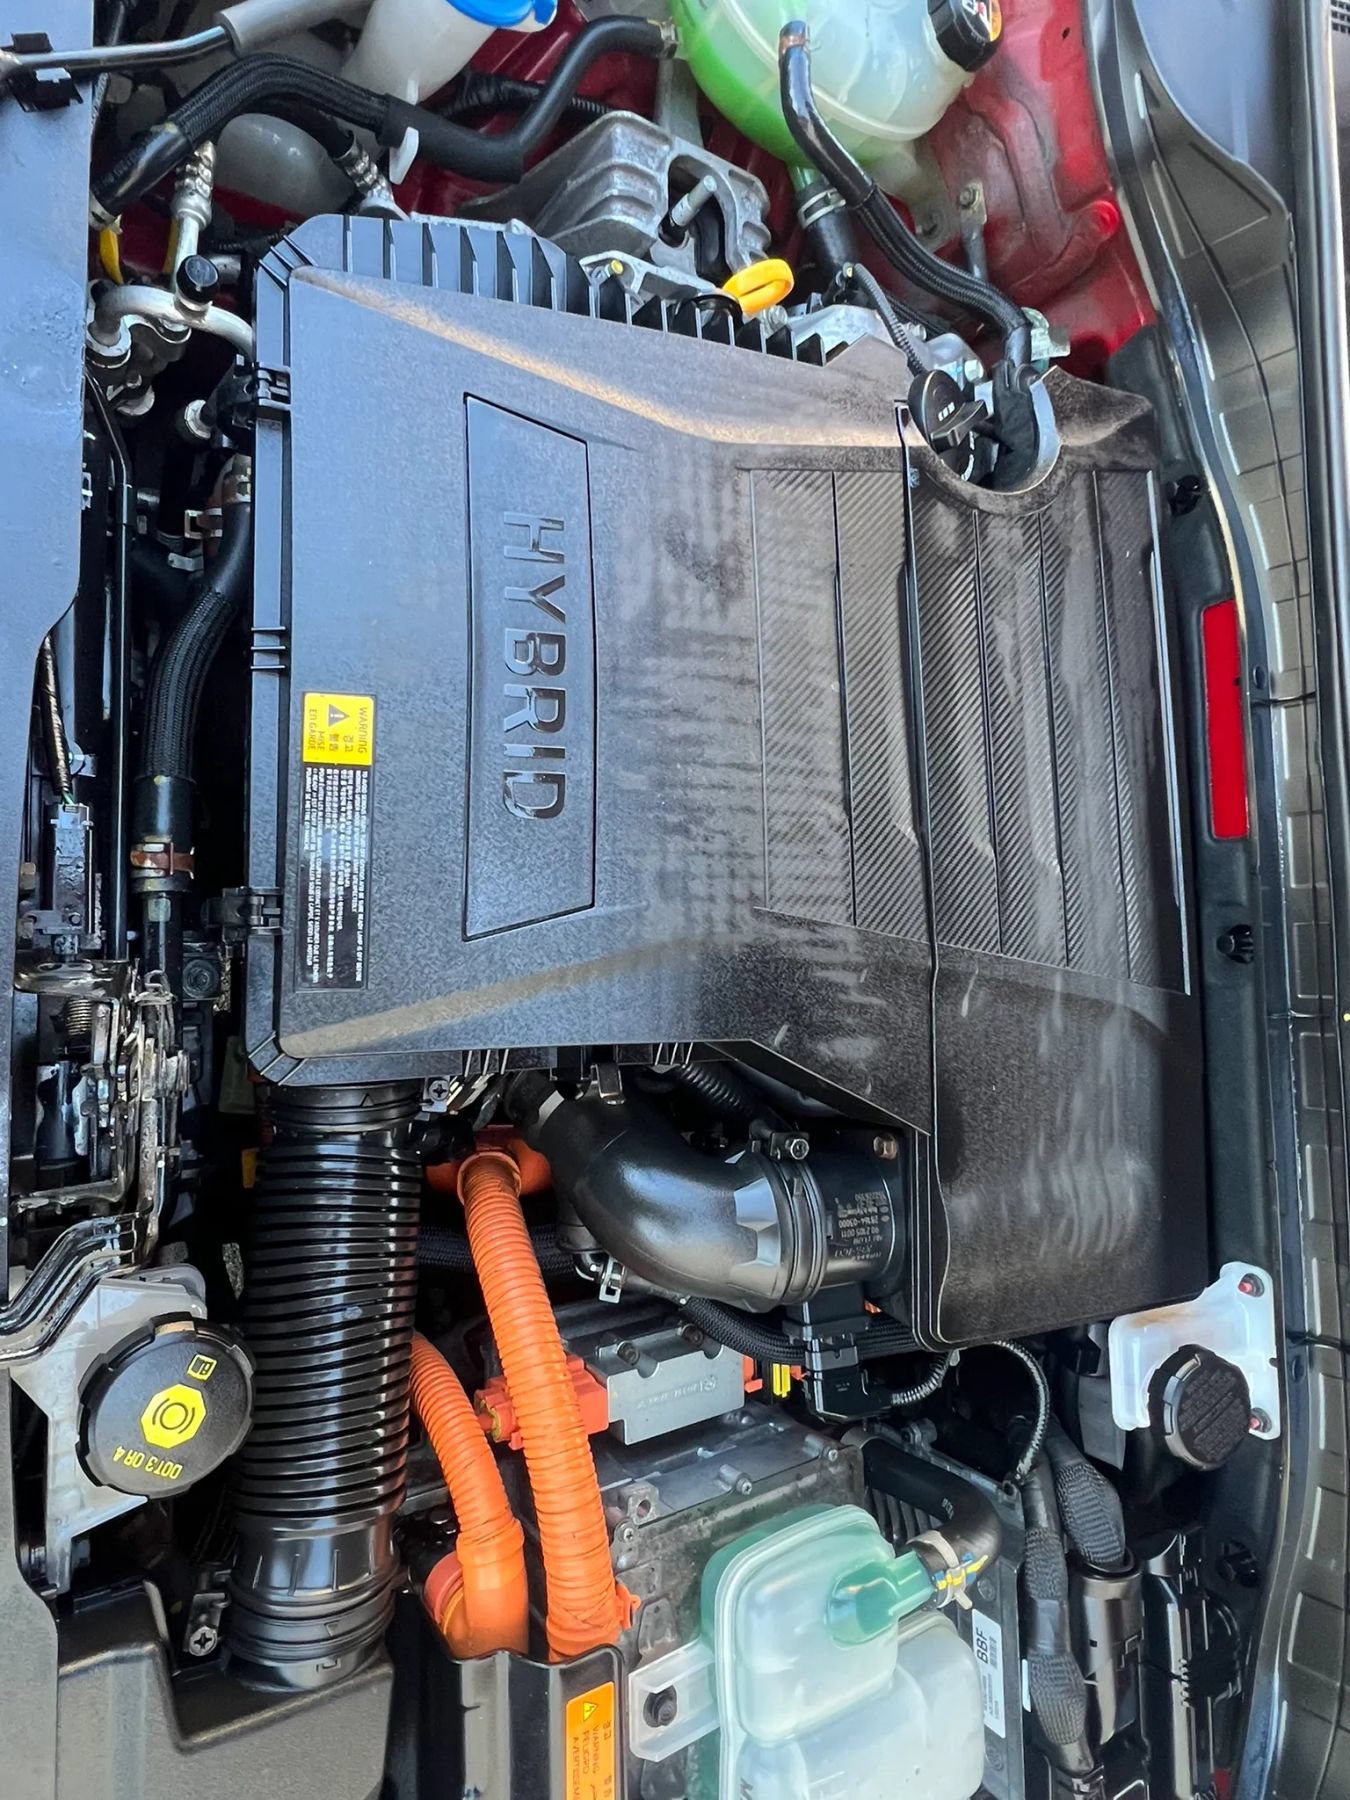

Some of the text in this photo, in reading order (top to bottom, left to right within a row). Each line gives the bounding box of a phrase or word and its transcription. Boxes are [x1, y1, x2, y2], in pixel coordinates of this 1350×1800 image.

[502, 510, 567, 820] HYBRID
[307, 708, 317, 751] EN GARDE
[317, 730, 326, 751] MISE
[358, 707, 368, 754] WARNING
[112, 1445, 127, 1463] 4
[123, 1449, 146, 1469] OR
